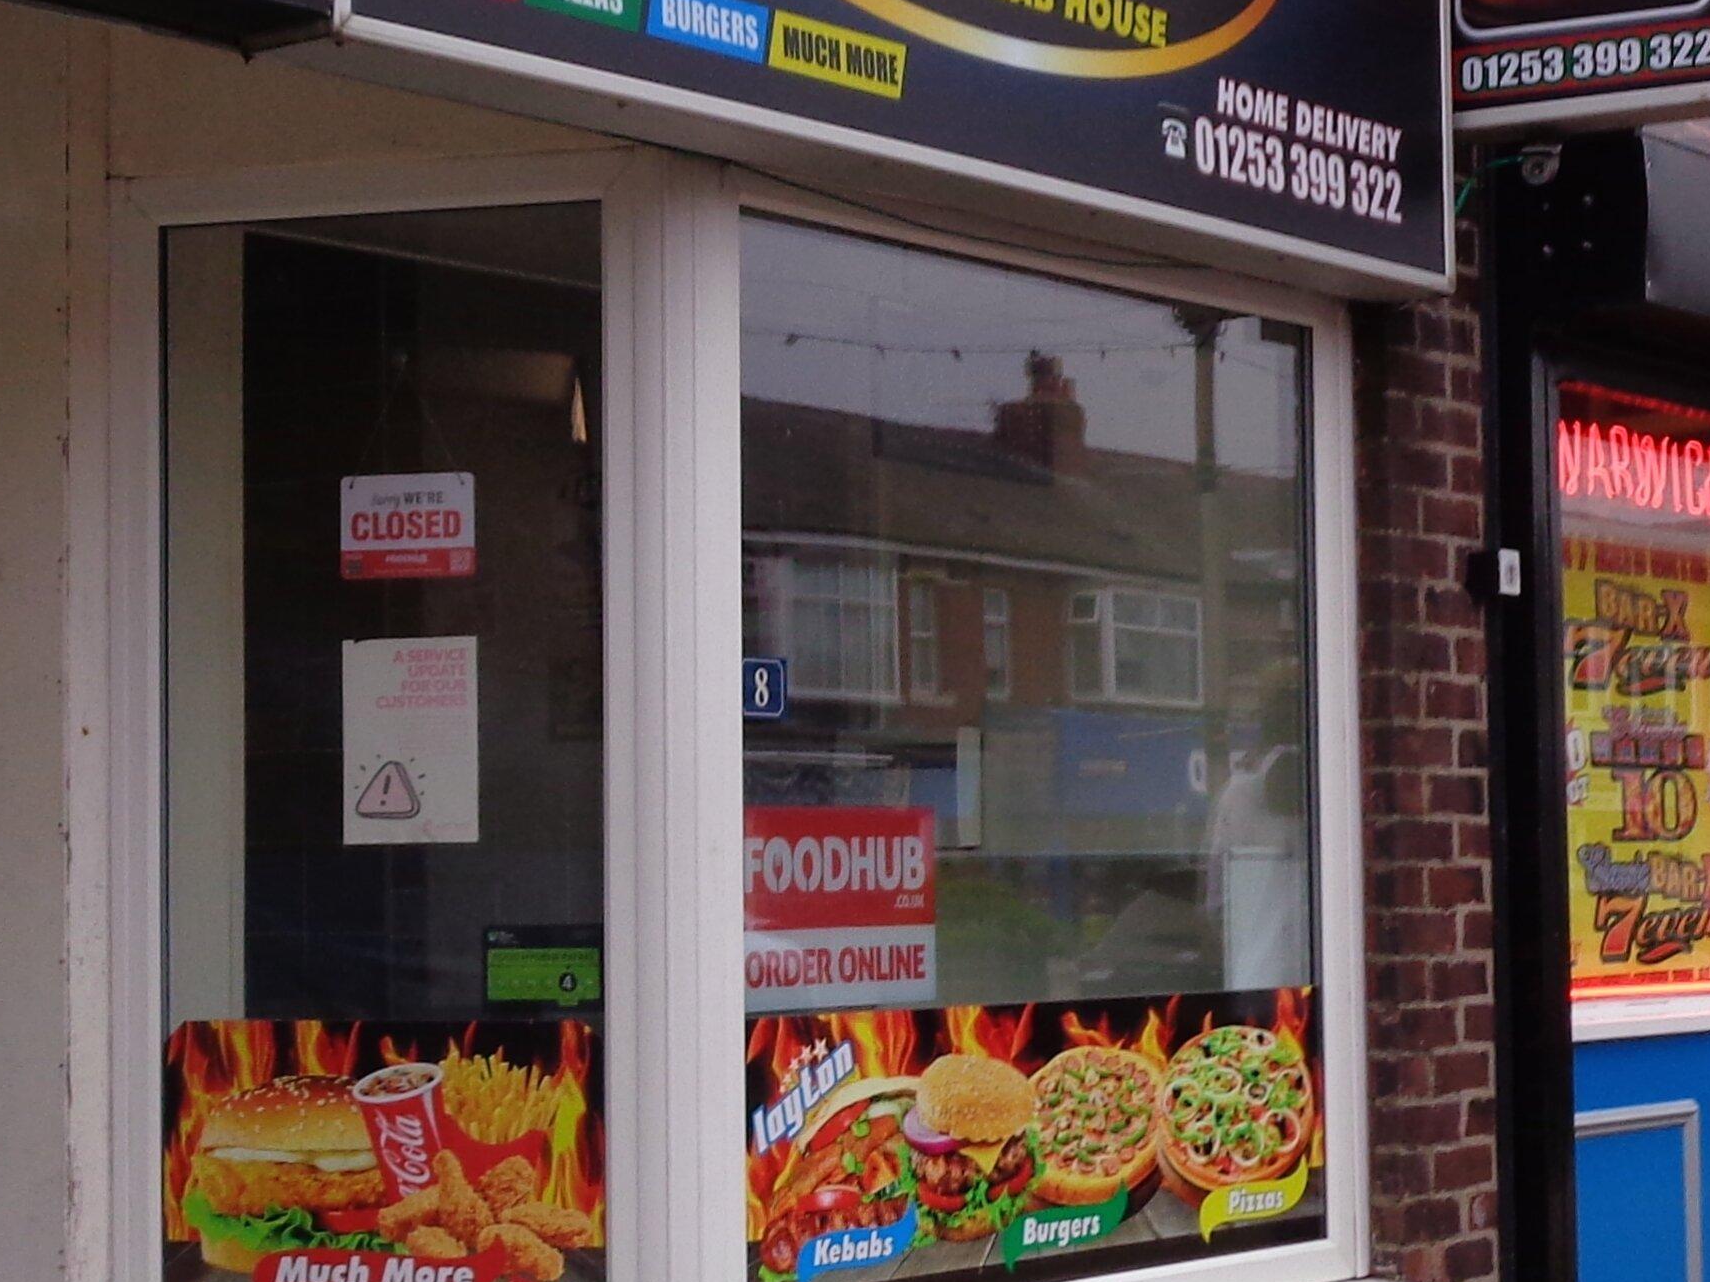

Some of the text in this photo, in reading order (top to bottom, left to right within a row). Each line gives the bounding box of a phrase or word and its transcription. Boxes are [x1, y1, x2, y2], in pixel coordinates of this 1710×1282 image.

[782, 24, 900, 87] MUCH MORE
[1461, 49, 1566, 92] 01253
[1572, 38, 1642, 79] 399
[1216, 77, 1403, 163] HOME DELIVERY
[1194, 116, 1403, 224] 01253 399 322
[351, 510, 462, 541] CLOSED
[754, 666, 770, 709] 8
[1611, 767, 1698, 842] 10
[744, 835, 927, 894] FOODHUB
[746, 943, 926, 989] ORDER ONLINE
[752, 1041, 855, 1156] layton
[1226, 1188, 1285, 1215] Pizzas
[813, 1233, 895, 1267] Kebabs
[1021, 1213, 1102, 1246] Burgers
